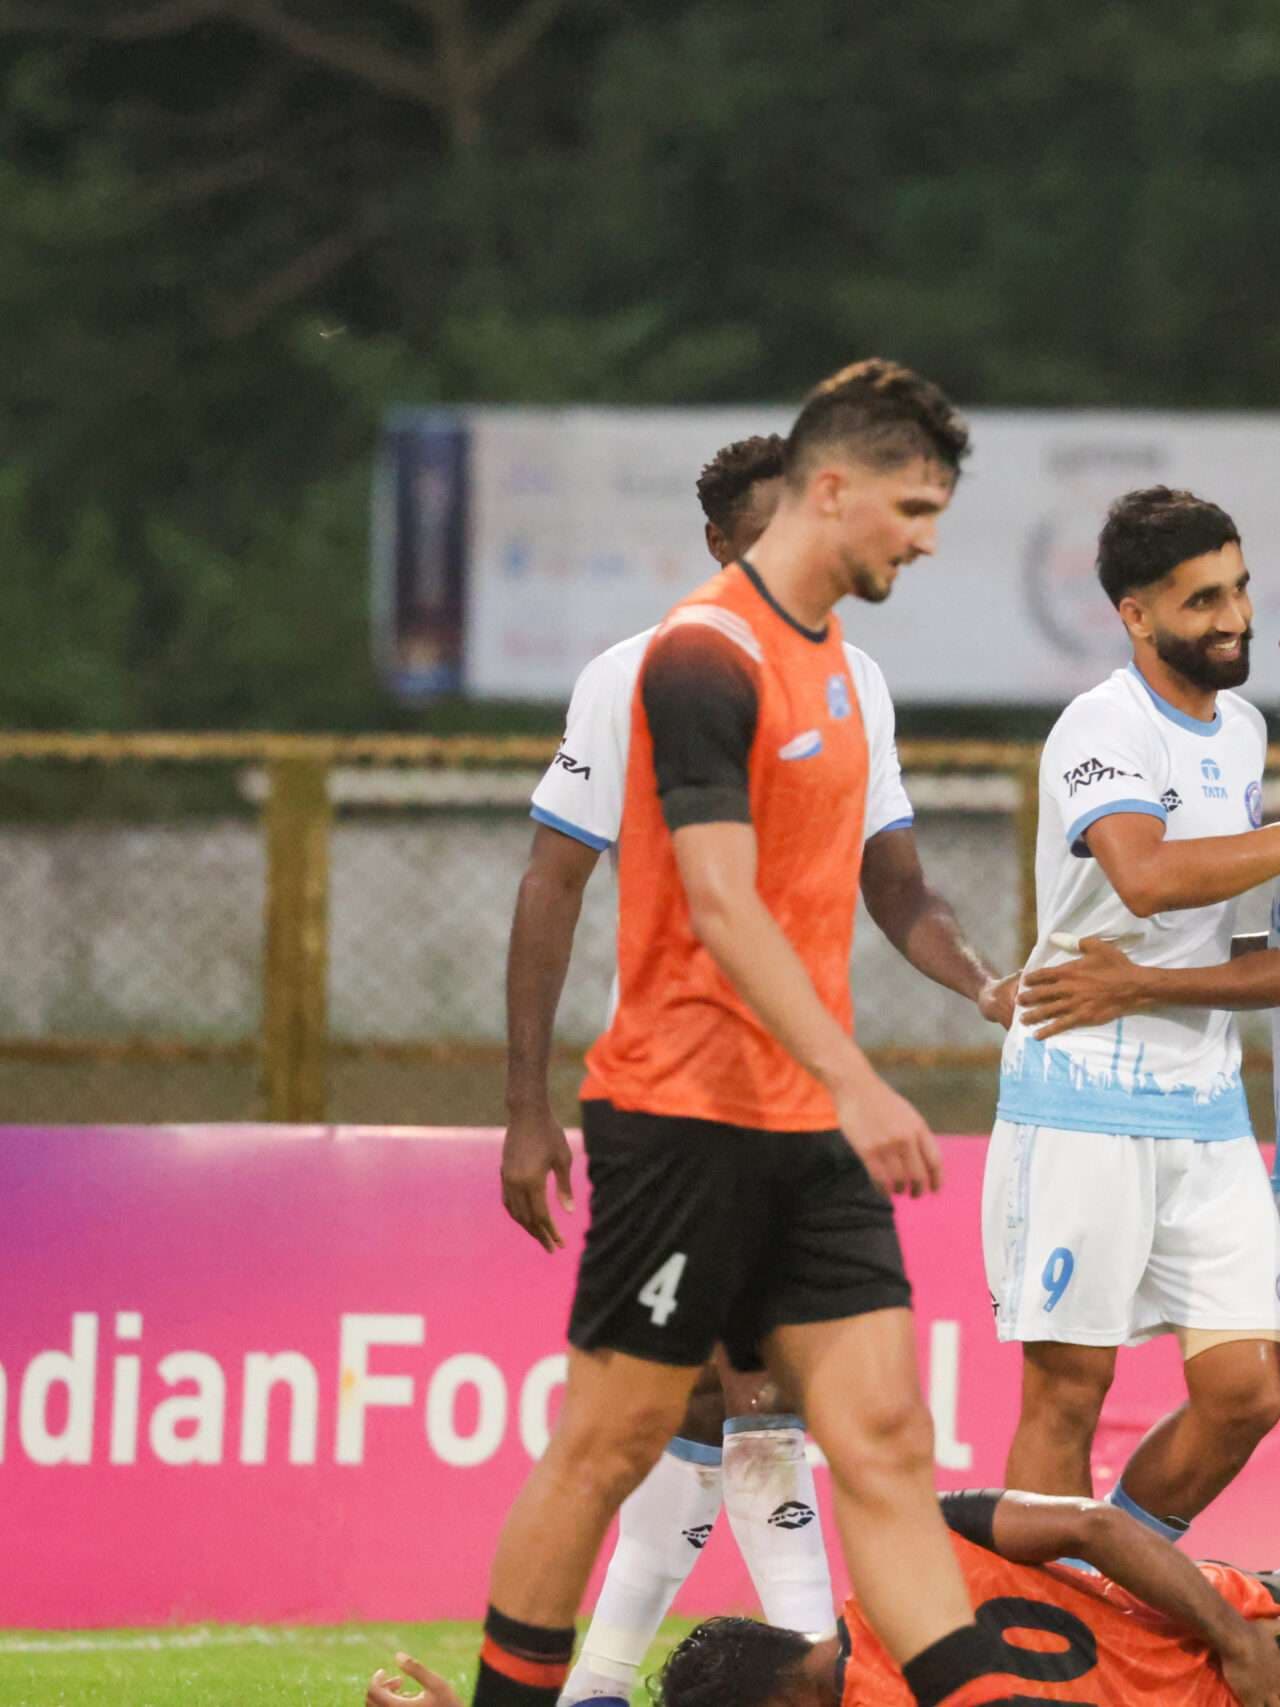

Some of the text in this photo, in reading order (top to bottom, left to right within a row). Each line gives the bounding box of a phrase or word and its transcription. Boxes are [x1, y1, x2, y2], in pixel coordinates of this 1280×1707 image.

[1063, 757, 1104, 784] TATA
[1201, 784, 1229, 800] TATA
[638, 1251, 687, 1326] 4
[1041, 1247, 1074, 1313] 9
